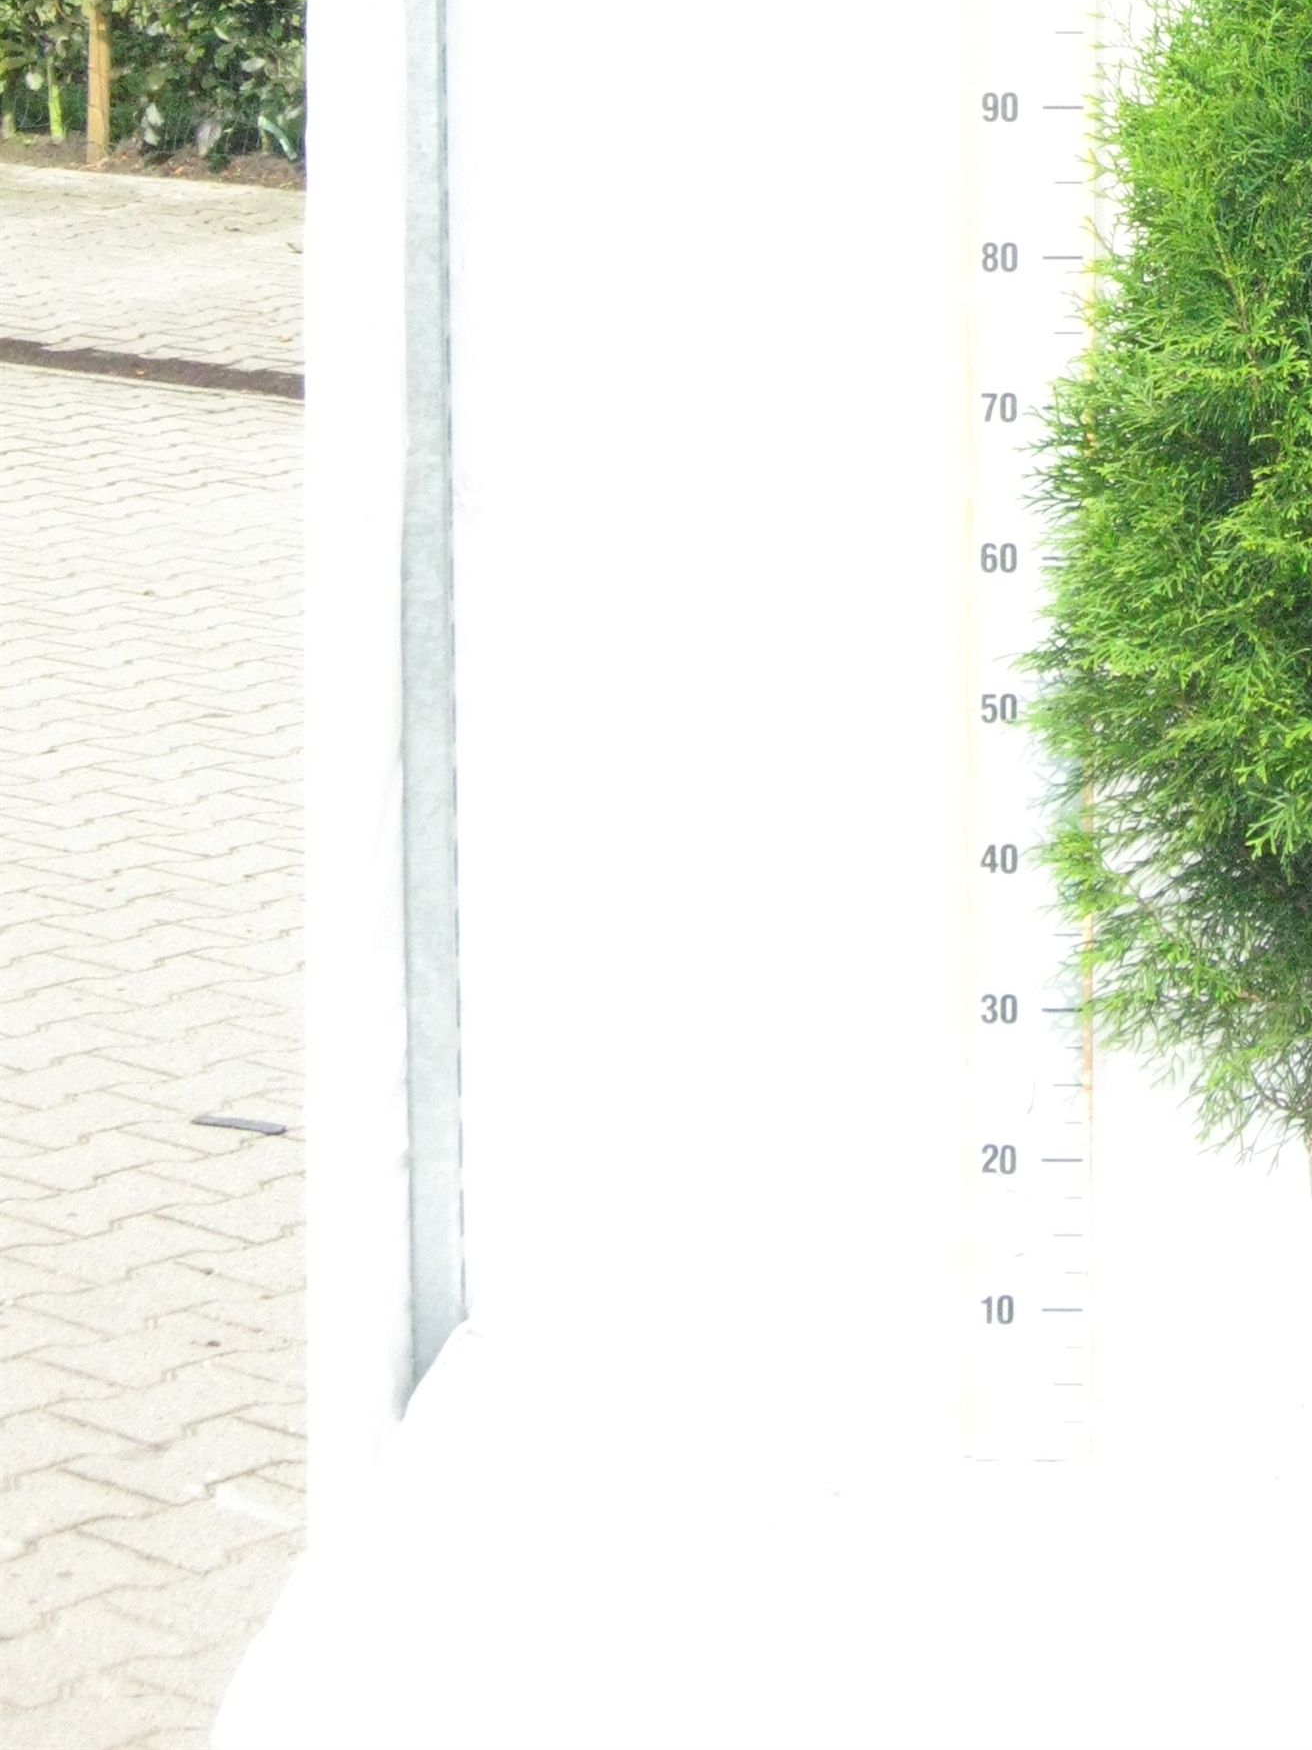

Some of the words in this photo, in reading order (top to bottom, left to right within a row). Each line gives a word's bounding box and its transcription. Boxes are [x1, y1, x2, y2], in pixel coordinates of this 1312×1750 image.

[981, 91, 1019, 123] 90
[981, 241, 1019, 274] 80
[980, 391, 1018, 424] 70
[979, 542, 1018, 574] 60
[980, 693, 1019, 724] 50
[980, 843, 1019, 875] 40
[980, 993, 1019, 1025] 30
[980, 1142, 1018, 1177] 20
[980, 1293, 1015, 1326] 10
